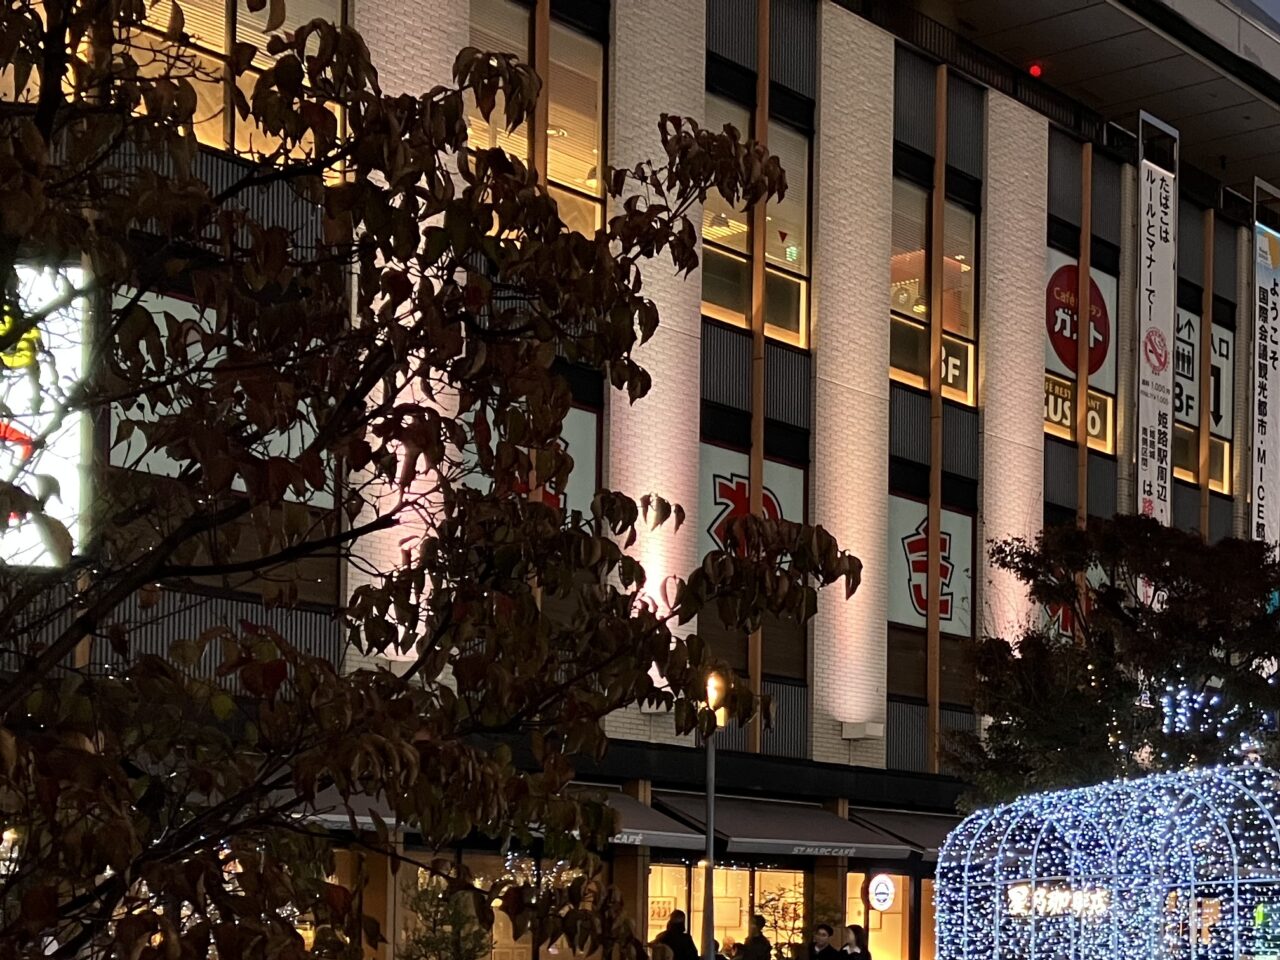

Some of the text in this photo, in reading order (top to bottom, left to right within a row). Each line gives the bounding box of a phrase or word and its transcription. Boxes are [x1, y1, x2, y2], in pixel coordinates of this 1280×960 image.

[1159, 175, 1171, 243] たばこは
[1269, 277, 1279, 371] ようこそ
[1045, 393, 1101, 436] USO
[613, 833, 643, 845] CAFÉ
